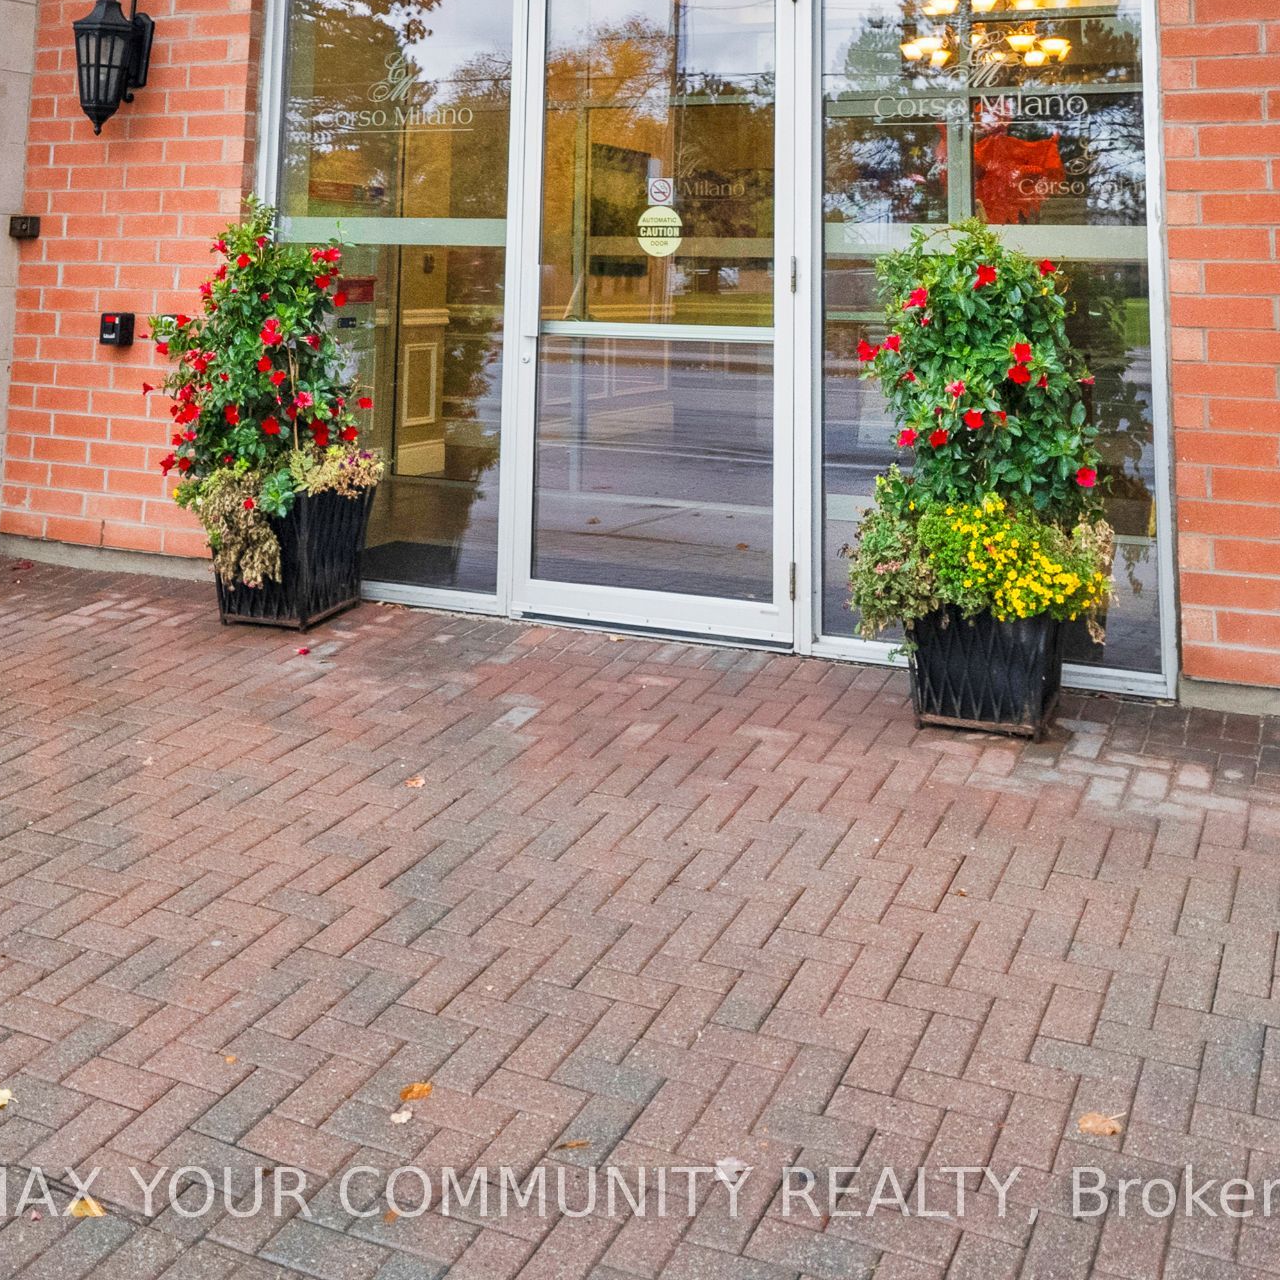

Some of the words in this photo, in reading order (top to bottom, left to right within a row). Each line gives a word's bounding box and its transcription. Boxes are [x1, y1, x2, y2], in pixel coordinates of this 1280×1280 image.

[874, 95, 969, 119] Corso
[979, 91, 1088, 118] Milano
[319, 107, 387, 128] Corso
[394, 105, 474, 127] Milano
[682, 180, 745, 197] Milano
[1018, 178, 1085, 195] Corso
[639, 226, 680, 237] CAUTION
